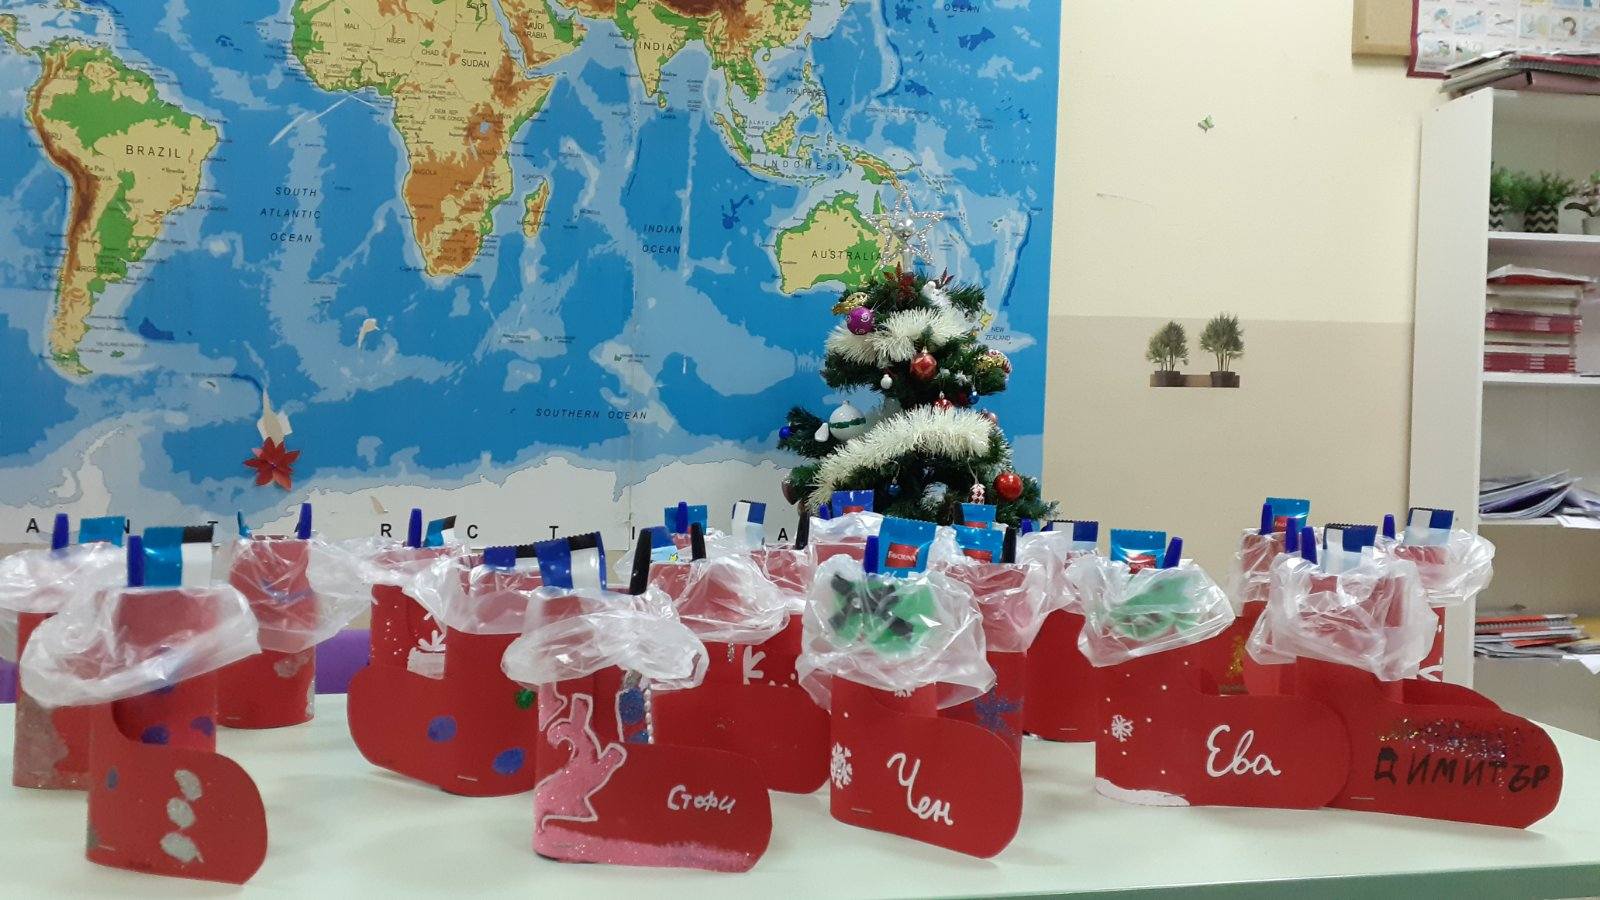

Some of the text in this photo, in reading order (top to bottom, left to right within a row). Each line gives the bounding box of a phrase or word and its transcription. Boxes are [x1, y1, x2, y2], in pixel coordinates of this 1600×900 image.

[344, 22, 360, 30] MALI
[639, 42, 674, 51] INDIA
[421, 49, 439, 57] CHAD
[461, 58, 490, 68] SUDAN
[126, 144, 182, 159] BRAZIL
[763, 159, 853, 173] INDONESIA
[275, 186, 317, 197] SOUTH
[260, 208, 321, 219] ATLANTIC
[643, 224, 683, 235] INDIAN
[270, 232, 313, 243] OCEAN
[642, 245, 681, 255] OCEAN
[811, 250, 882, 261] AUSTRALIA
[536, 408, 648, 421] SOUTHERN OCEAN
[1206, 724, 1282, 778] Ева
[1374, 747, 1550, 793] ДИМИТЪР
[886, 752, 954, 826] Чен
